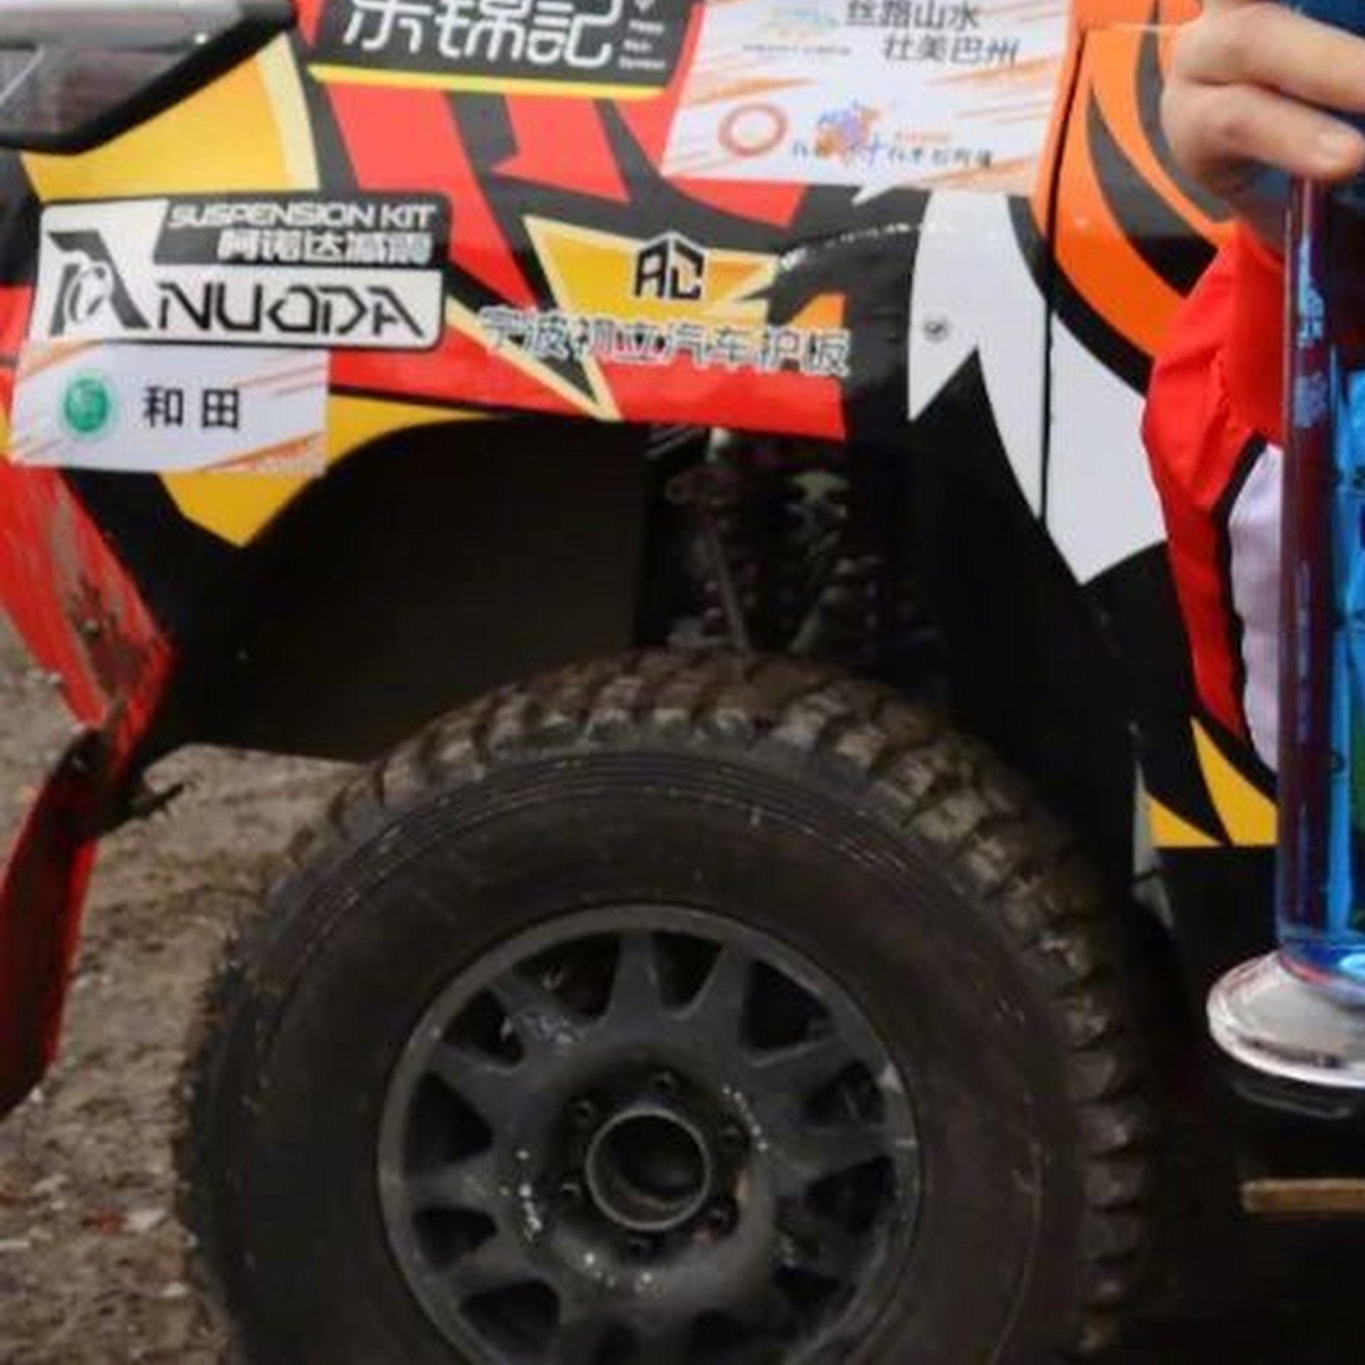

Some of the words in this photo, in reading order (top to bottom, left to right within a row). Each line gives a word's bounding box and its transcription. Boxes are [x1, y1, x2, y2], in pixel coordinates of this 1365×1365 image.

[881, 34, 1021, 68] 壮美巴州
[168, 202, 375, 229] SUSPENSION
[381, 203, 437, 228] KIT
[143, 385, 242, 430] 和田
